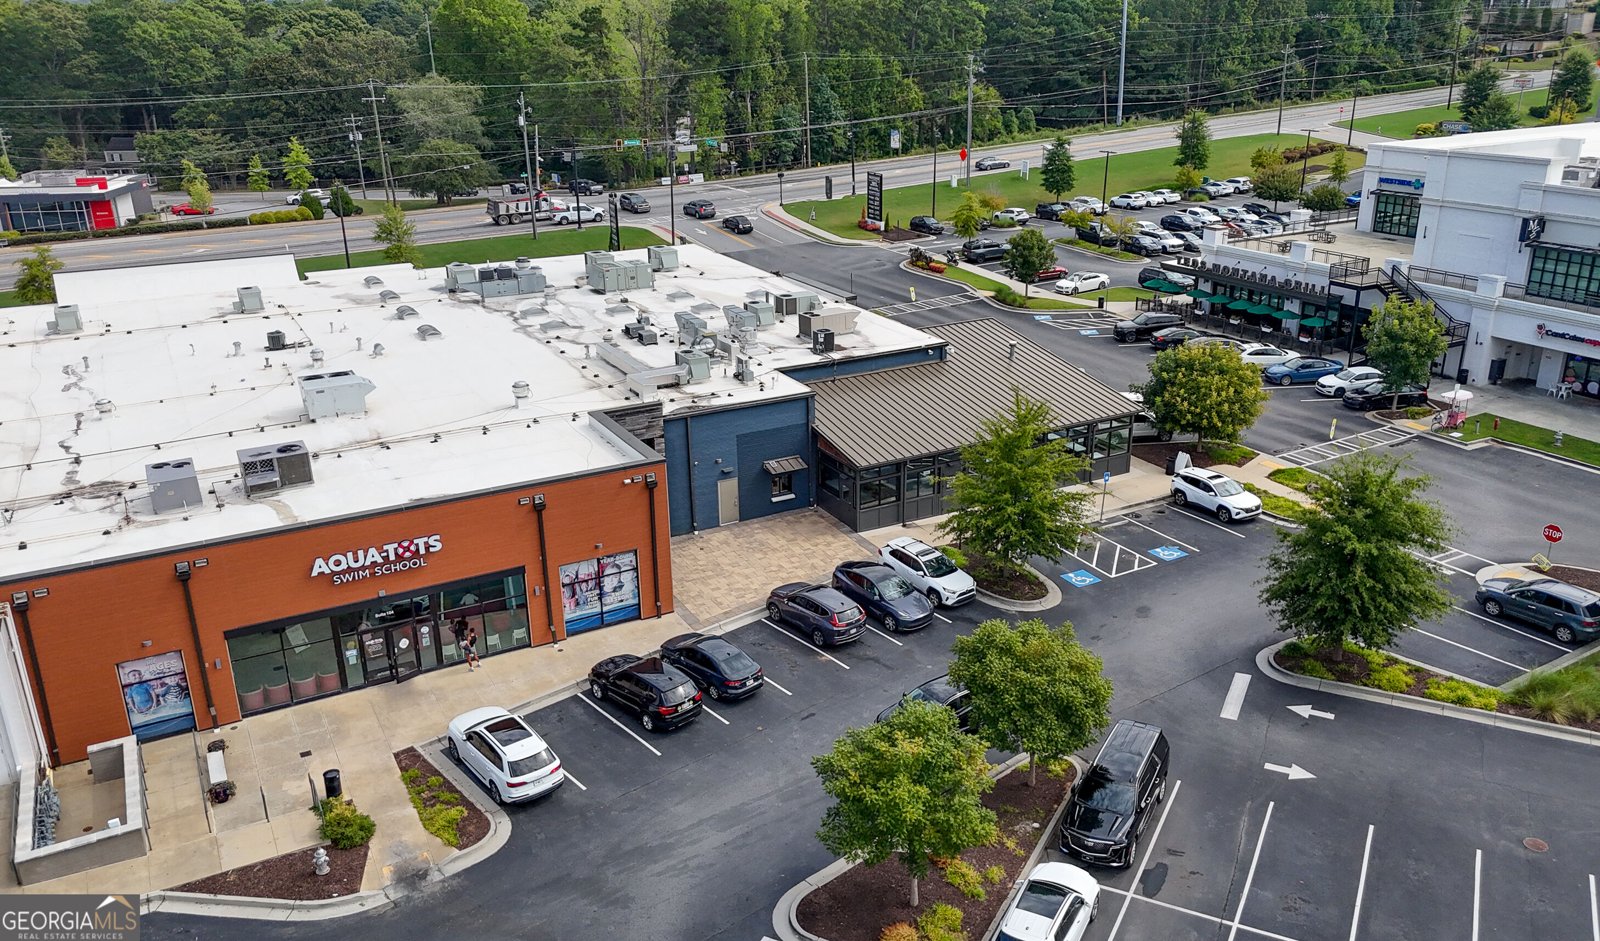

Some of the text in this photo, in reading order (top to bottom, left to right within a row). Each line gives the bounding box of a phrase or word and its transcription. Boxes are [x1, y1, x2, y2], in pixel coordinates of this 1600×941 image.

[1212, 263, 1277, 287] MONTANA
[1284, 278, 1328, 297] GRILL
[1543, 528, 1562, 539] STOP
[310, 534, 443, 577] AQUA-TOTS
[333, 558, 428, 585] SWIM SCHOOL
